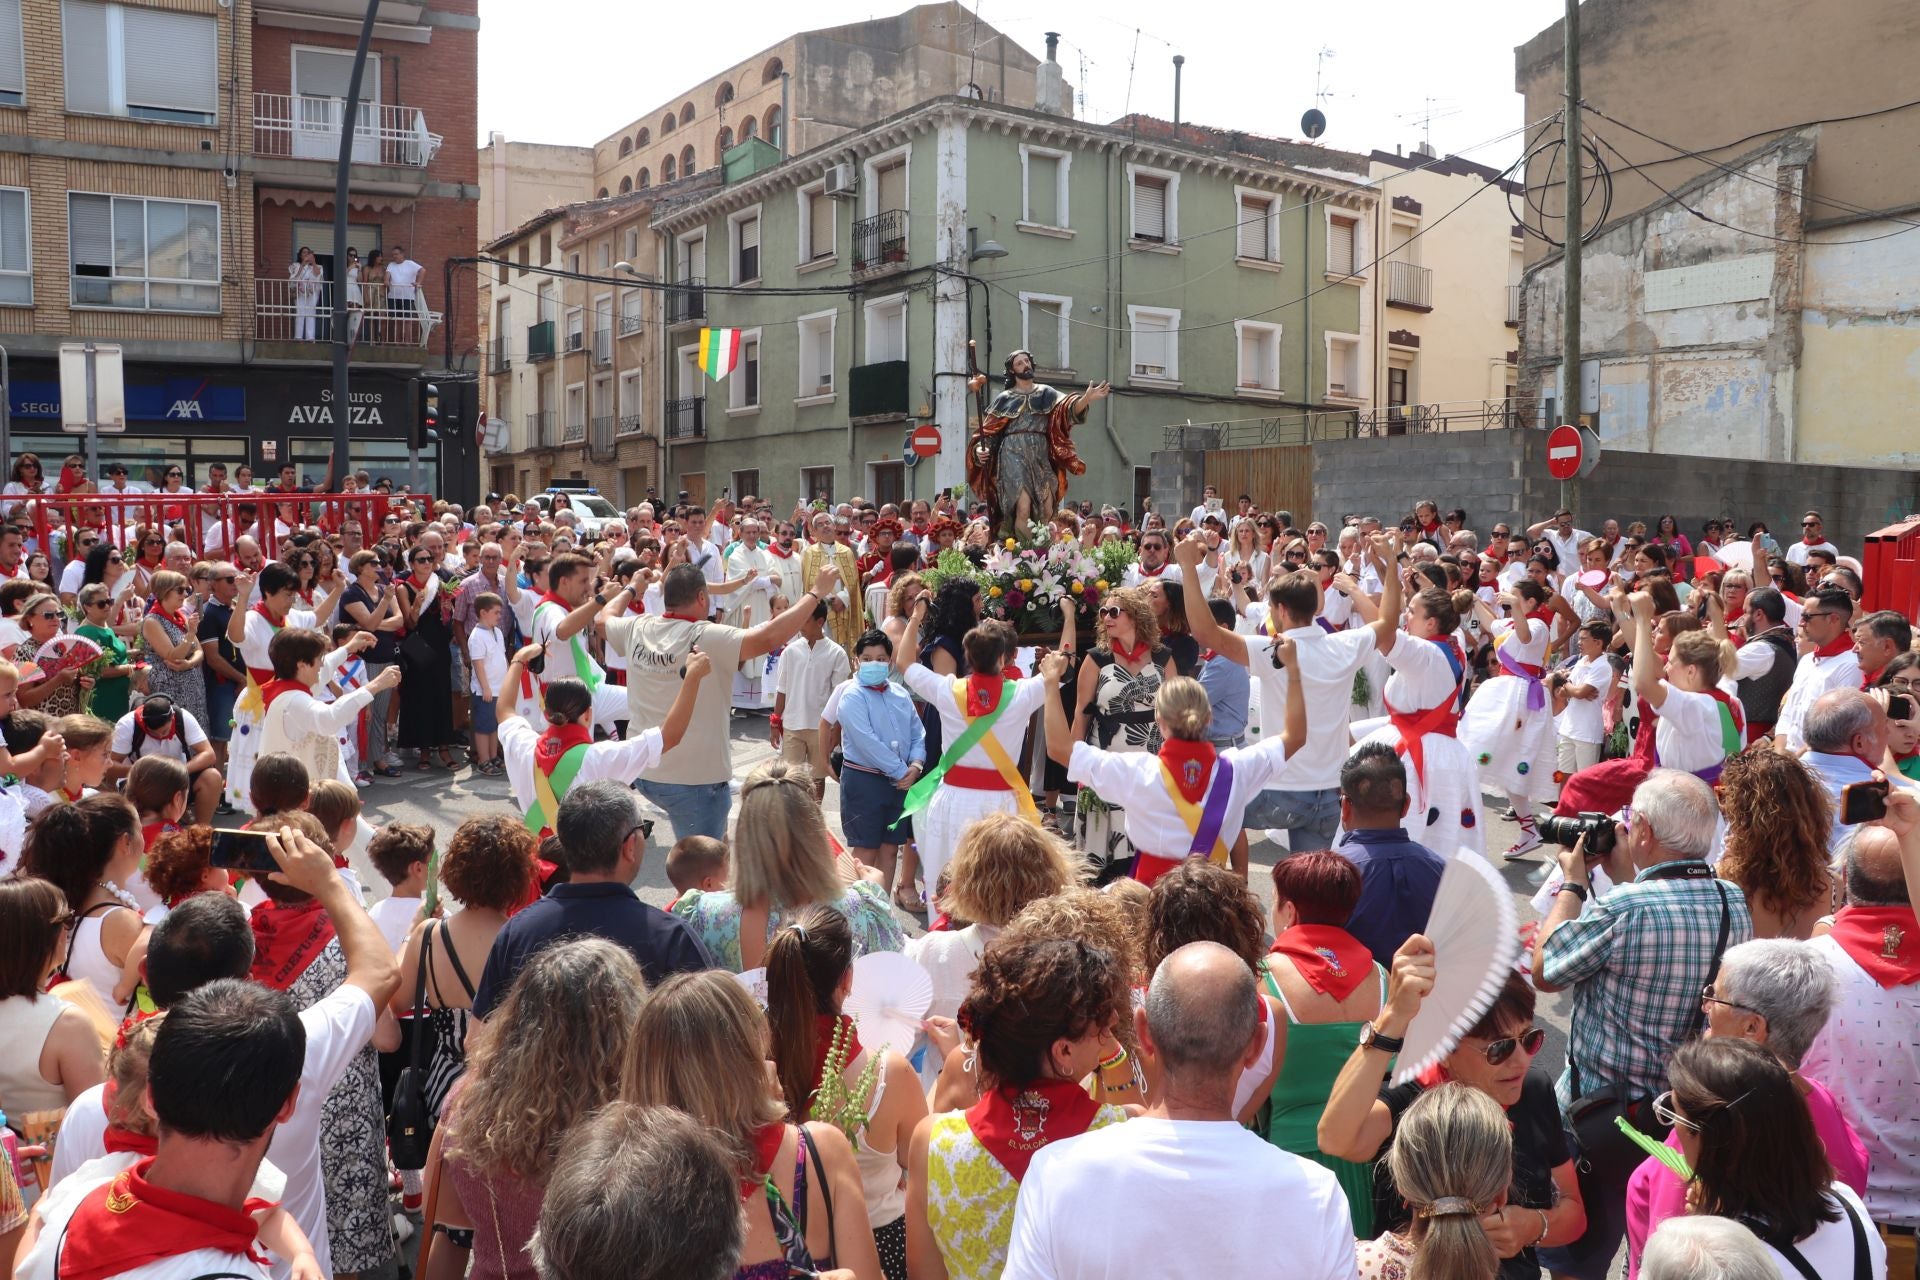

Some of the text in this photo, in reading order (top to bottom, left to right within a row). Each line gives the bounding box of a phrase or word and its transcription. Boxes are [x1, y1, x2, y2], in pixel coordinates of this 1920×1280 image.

[321, 389, 382, 403] Suros
[21, 402, 60, 413] SEGU
[166, 400, 204, 418] AXA
[1470, 619, 1480, 629] 9
[1008, 1136, 1047, 1150] EL VOLCAN
